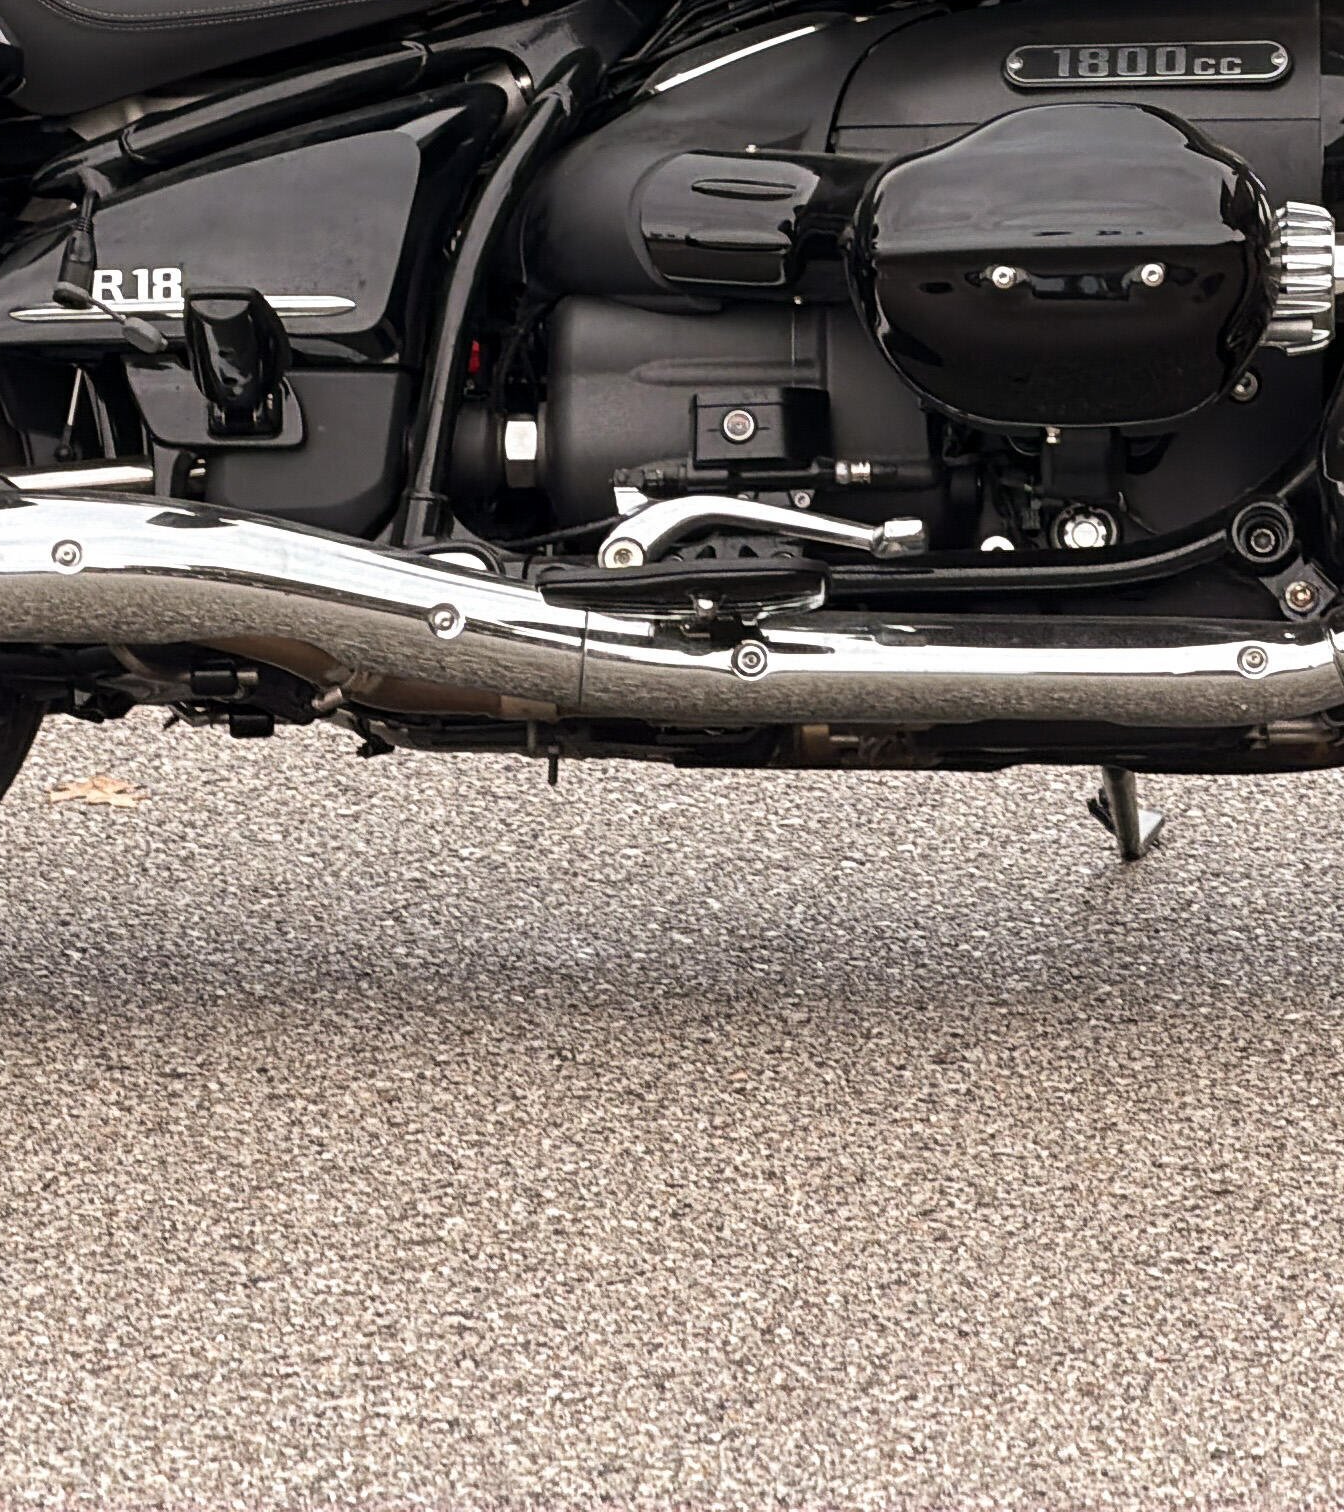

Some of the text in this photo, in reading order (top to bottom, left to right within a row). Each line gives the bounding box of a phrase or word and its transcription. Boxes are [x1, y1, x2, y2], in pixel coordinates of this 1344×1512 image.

[1053, 46, 1242, 77] 1800cc
[92, 267, 183, 302] R 18
